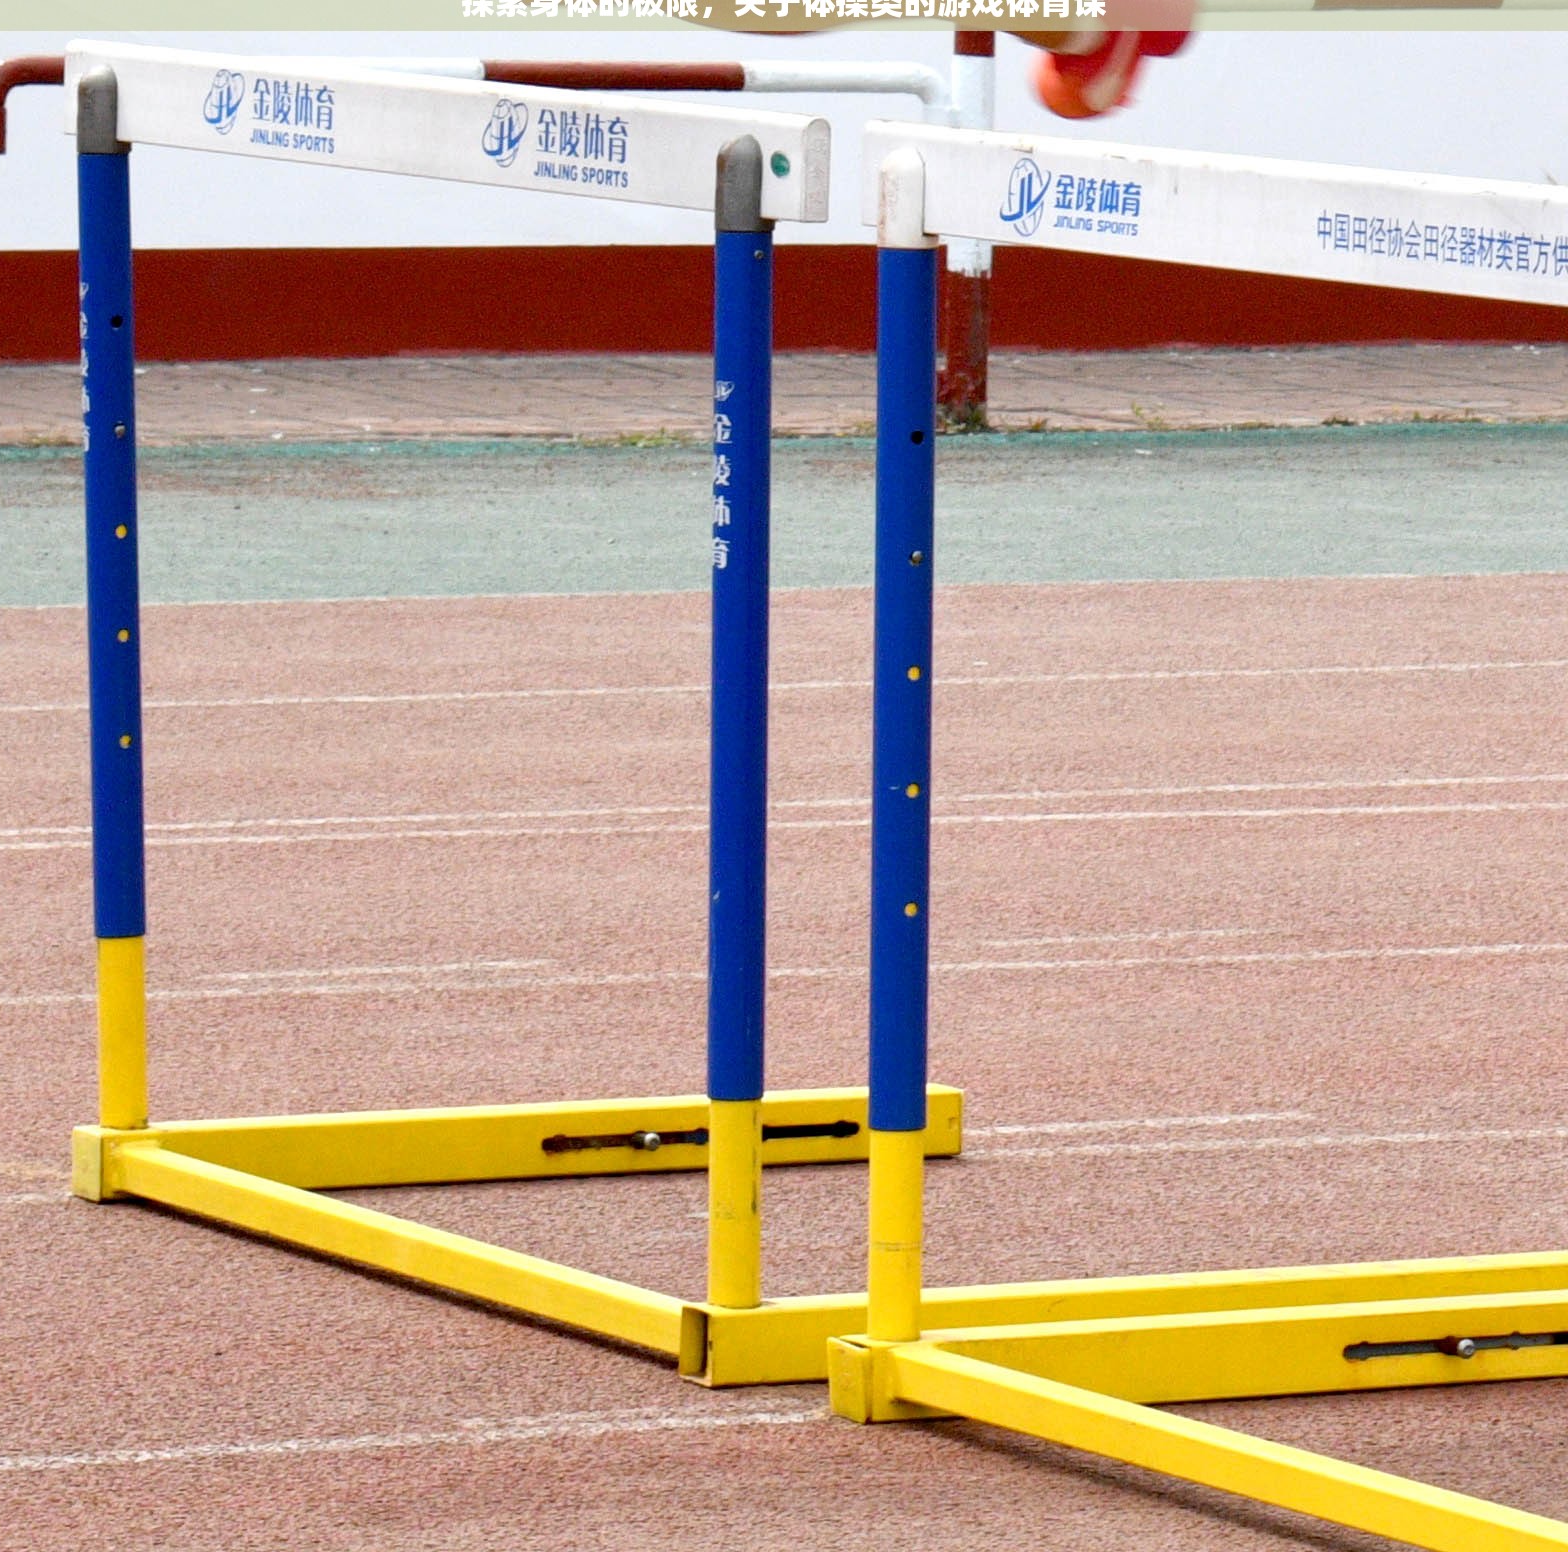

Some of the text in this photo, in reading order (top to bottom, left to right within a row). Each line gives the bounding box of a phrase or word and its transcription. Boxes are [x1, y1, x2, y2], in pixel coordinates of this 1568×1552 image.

[251, 78, 336, 131] 金陵体育
[250, 129, 335, 154] JINLING SPORTS
[536, 109, 630, 164] 金陵体育
[533, 161, 629, 188] JINLING SPORTS
[1054, 174, 1143, 217] 金陵体育
[1053, 215, 1139, 237] JINLING SPORTS
